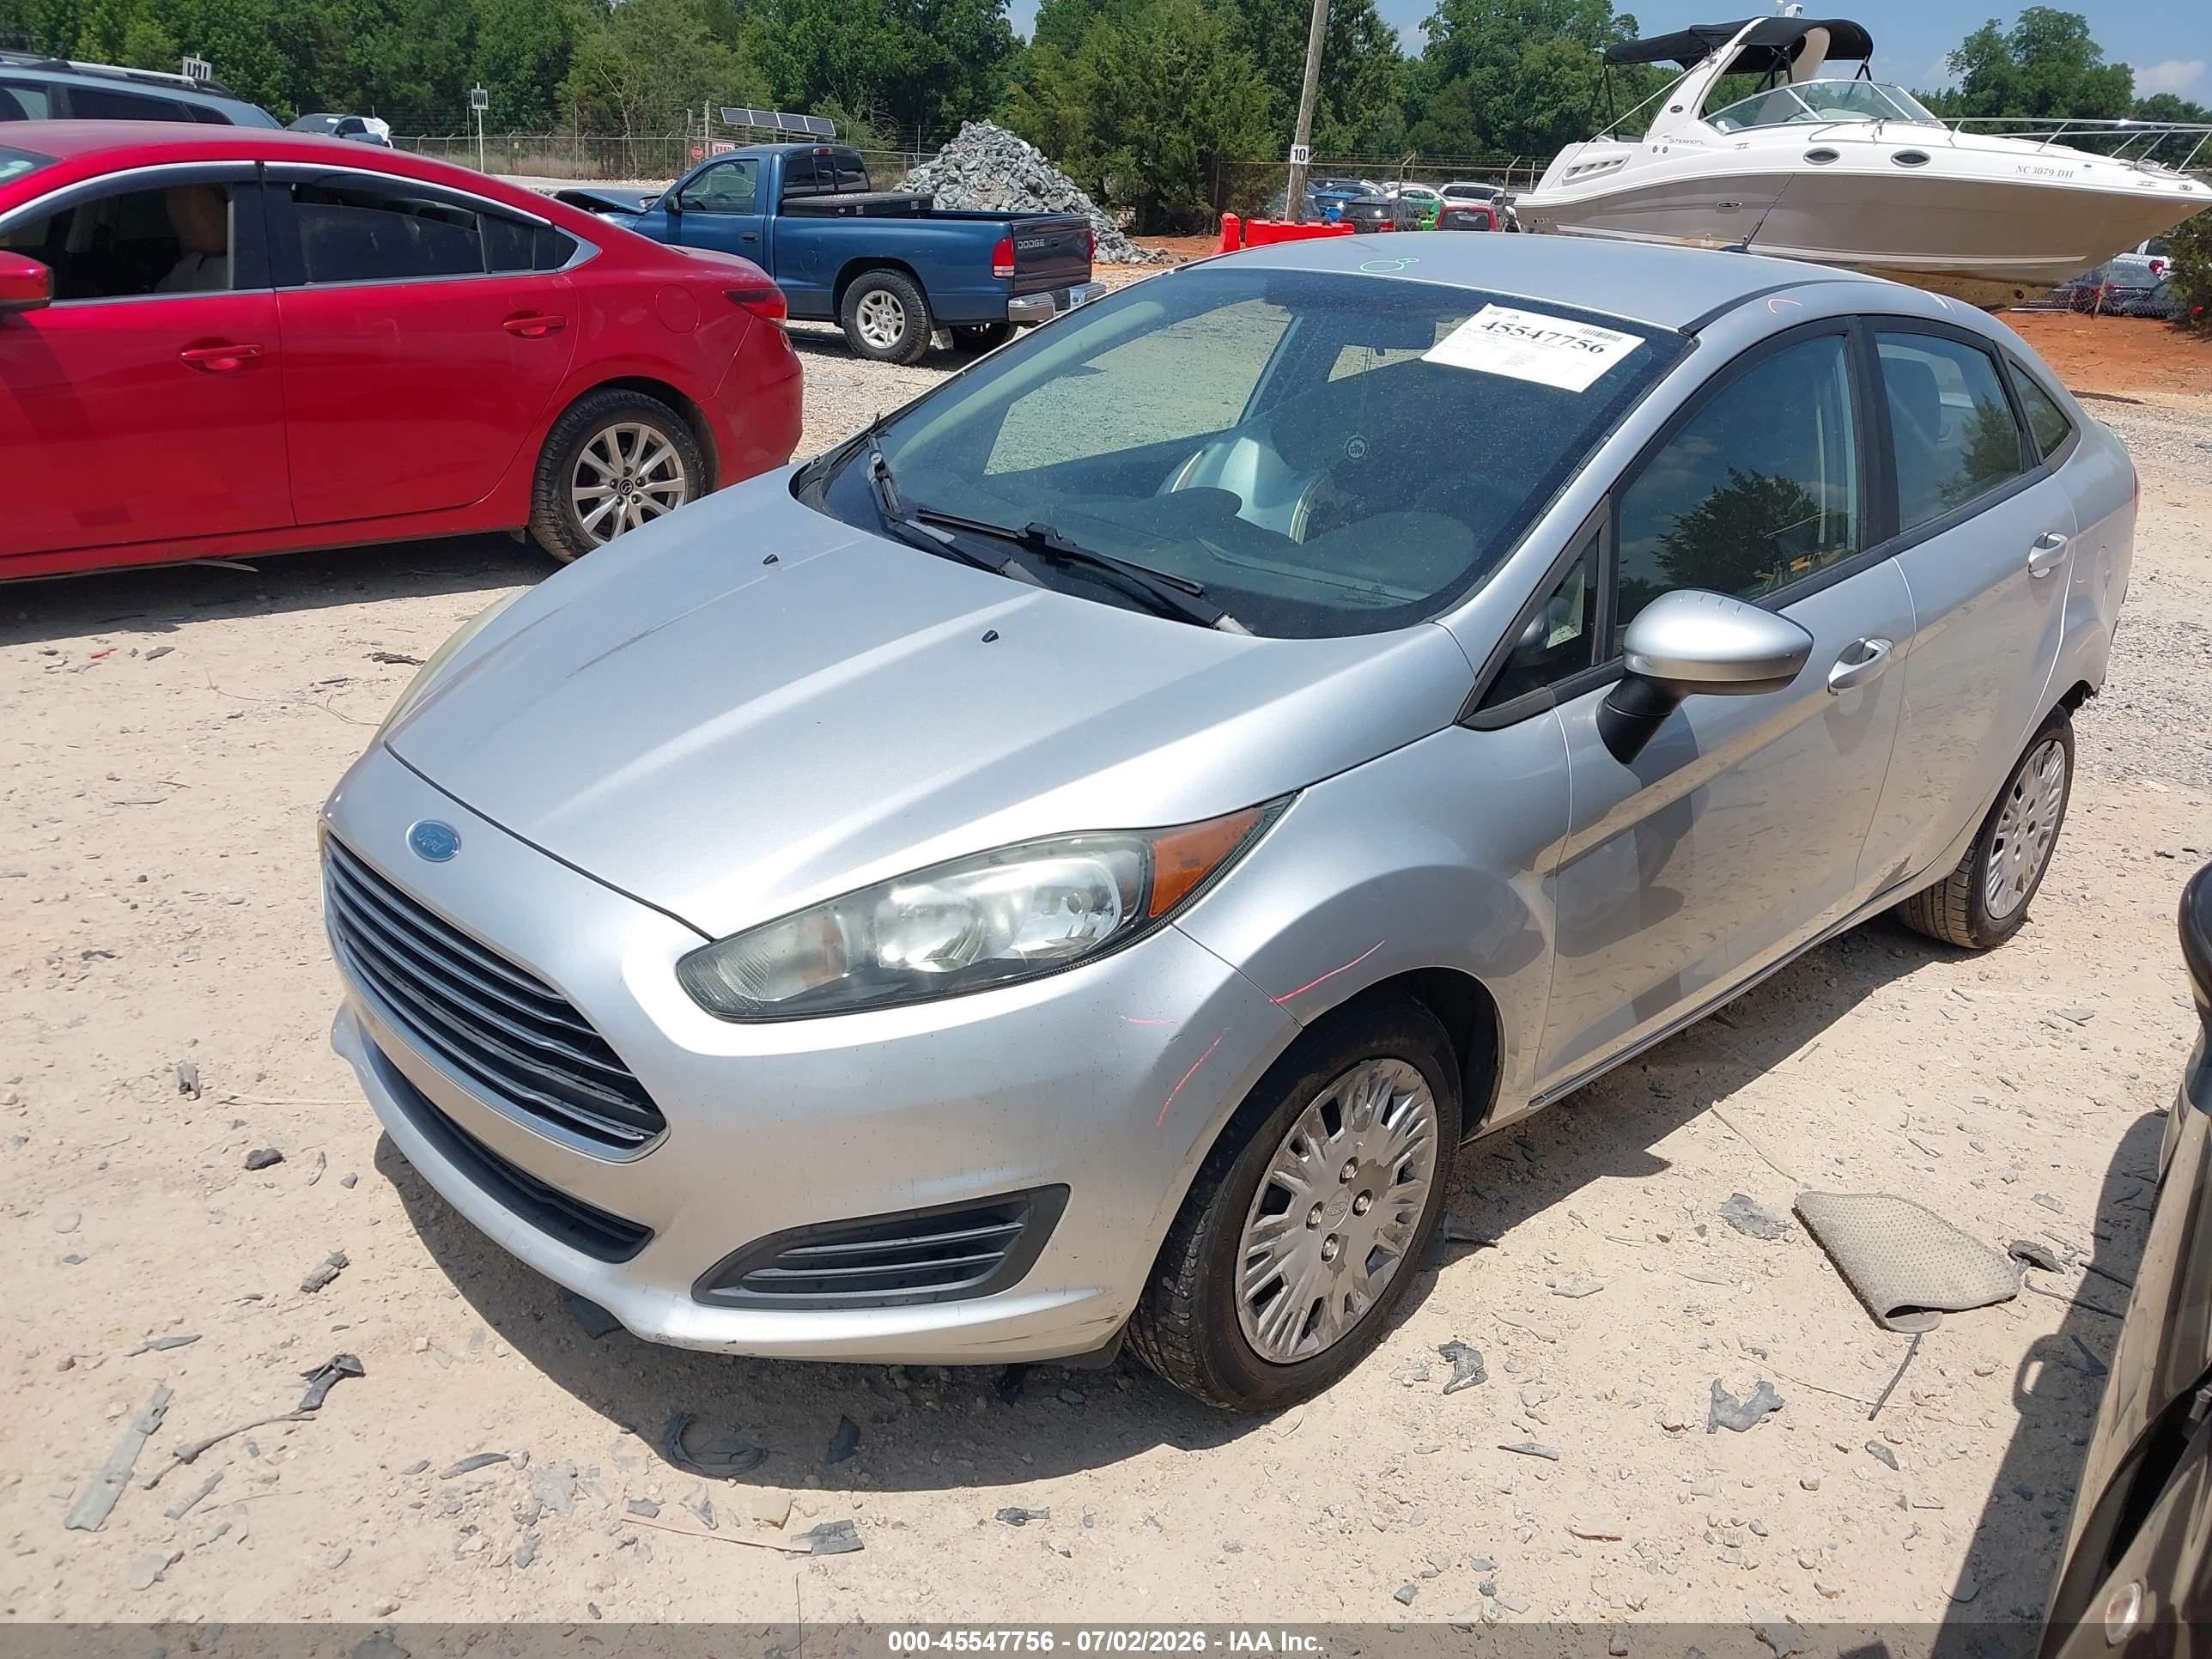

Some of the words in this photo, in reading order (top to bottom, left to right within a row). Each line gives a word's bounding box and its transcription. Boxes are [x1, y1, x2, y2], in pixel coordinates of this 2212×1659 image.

[1293, 148, 1306, 161] 10
[2015, 165, 2030, 173] NC
[2033, 167, 2055, 177] 3079
[1018, 239, 1045, 249] DODGE
[1480, 320, 1608, 354] 45547756
